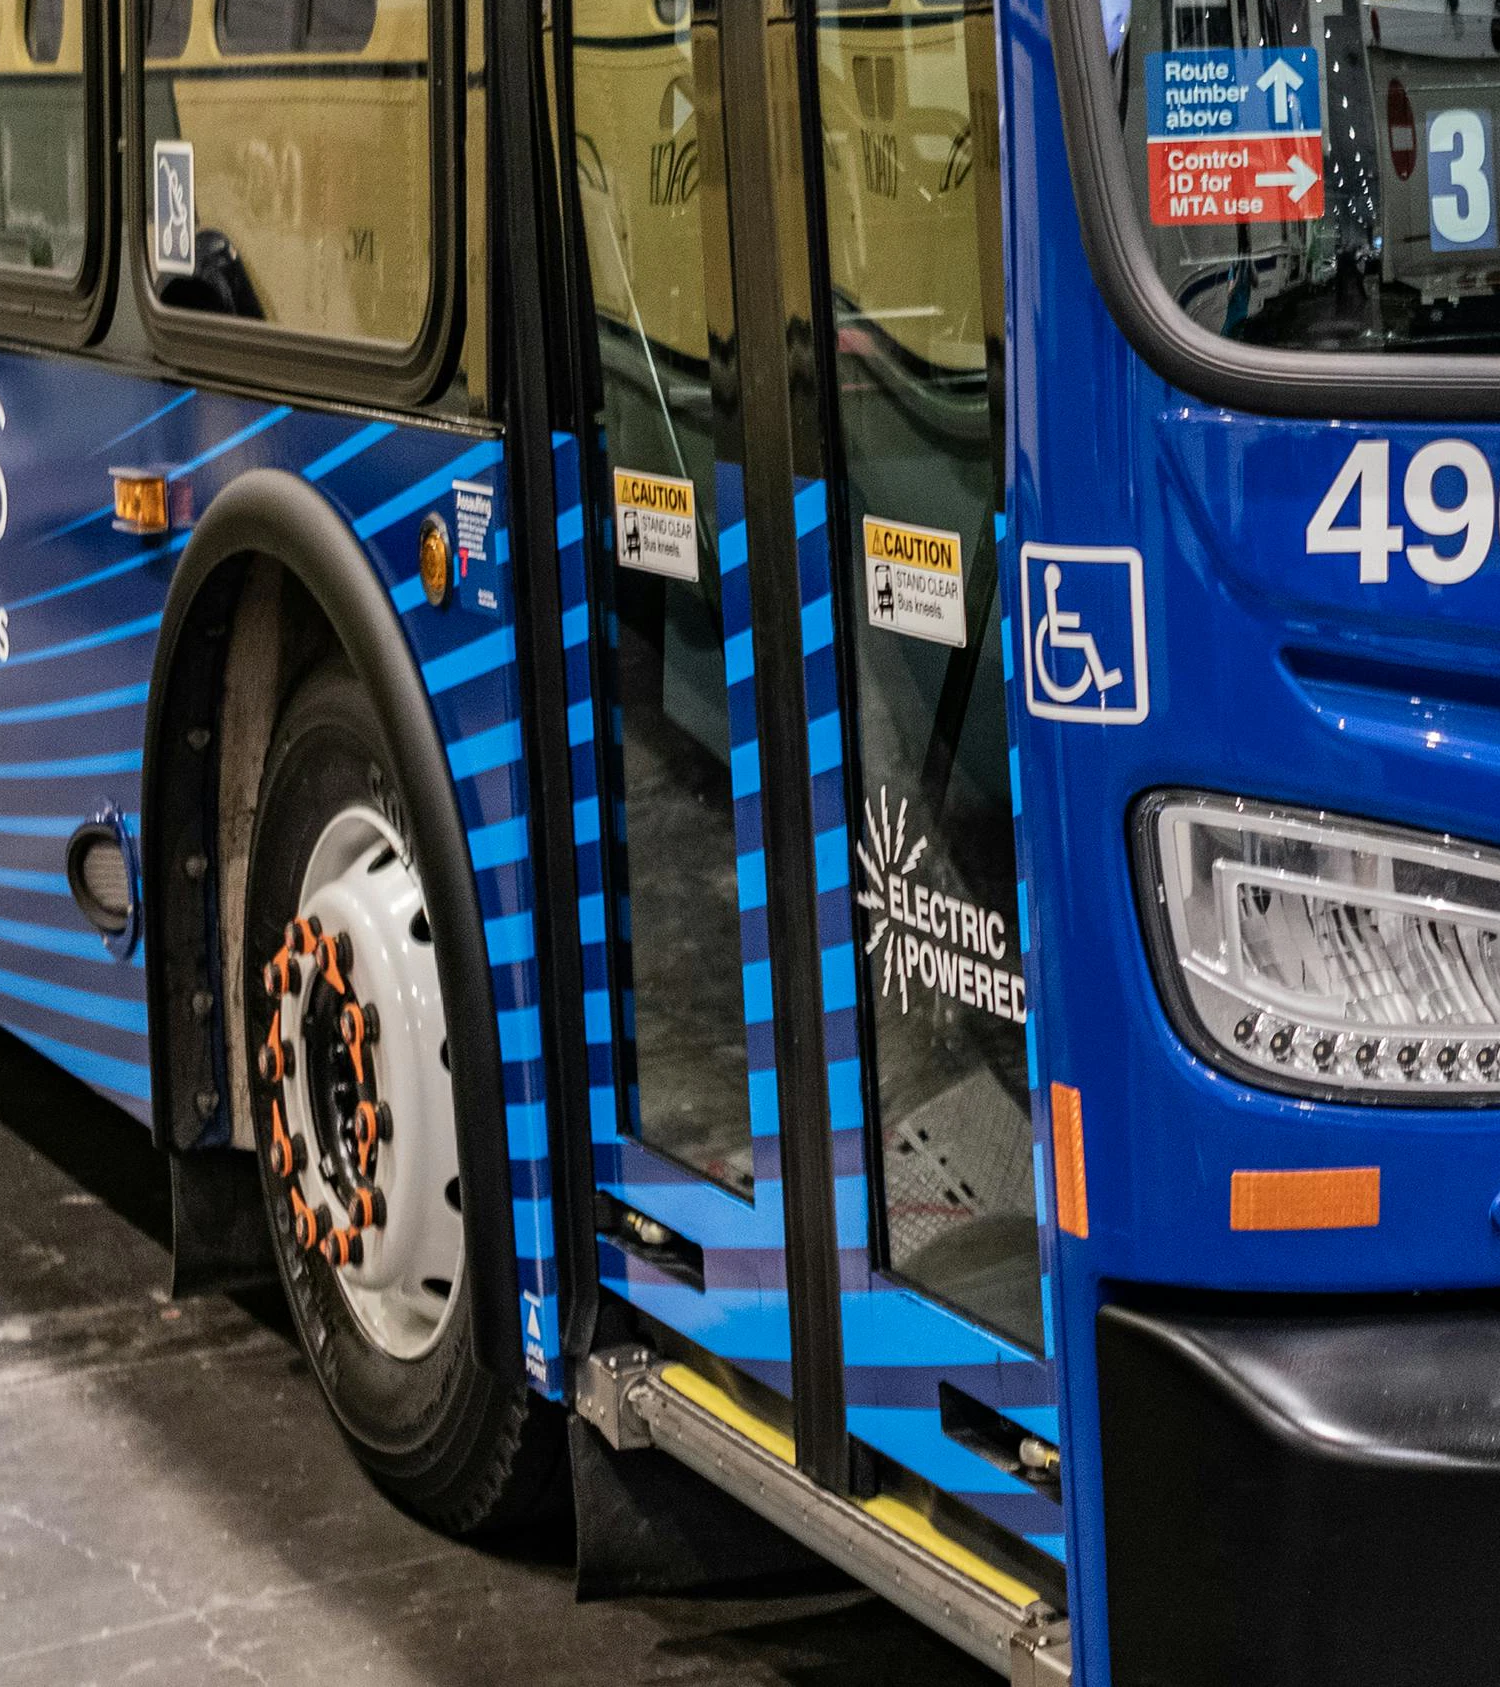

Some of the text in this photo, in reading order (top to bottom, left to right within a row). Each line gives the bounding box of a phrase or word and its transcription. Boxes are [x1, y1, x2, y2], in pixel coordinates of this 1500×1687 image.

[1164, 60, 1229, 82] Route
[1165, 84, 1249, 106] number
[1166, 108, 1233, 129] above
[1167, 148, 1249, 171] Control
[1169, 172, 1232, 194] ID for
[1170, 196, 1264, 217] MTA use
[631, 480, 688, 512] CAUTION
[641, 514, 693, 540] STAND CLEAR
[643, 535, 657, 553] Bus
[883, 531, 952, 570] CAUTION
[896, 570, 959, 601] STAND CLEAR
[897, 593, 914, 613] Bus
[888, 872, 1007, 961] ELECTRIC
[904, 933, 1028, 1025] POWERED
[526, 1340, 545, 1365] JACK
[525, 1354, 547, 1384] POINT
